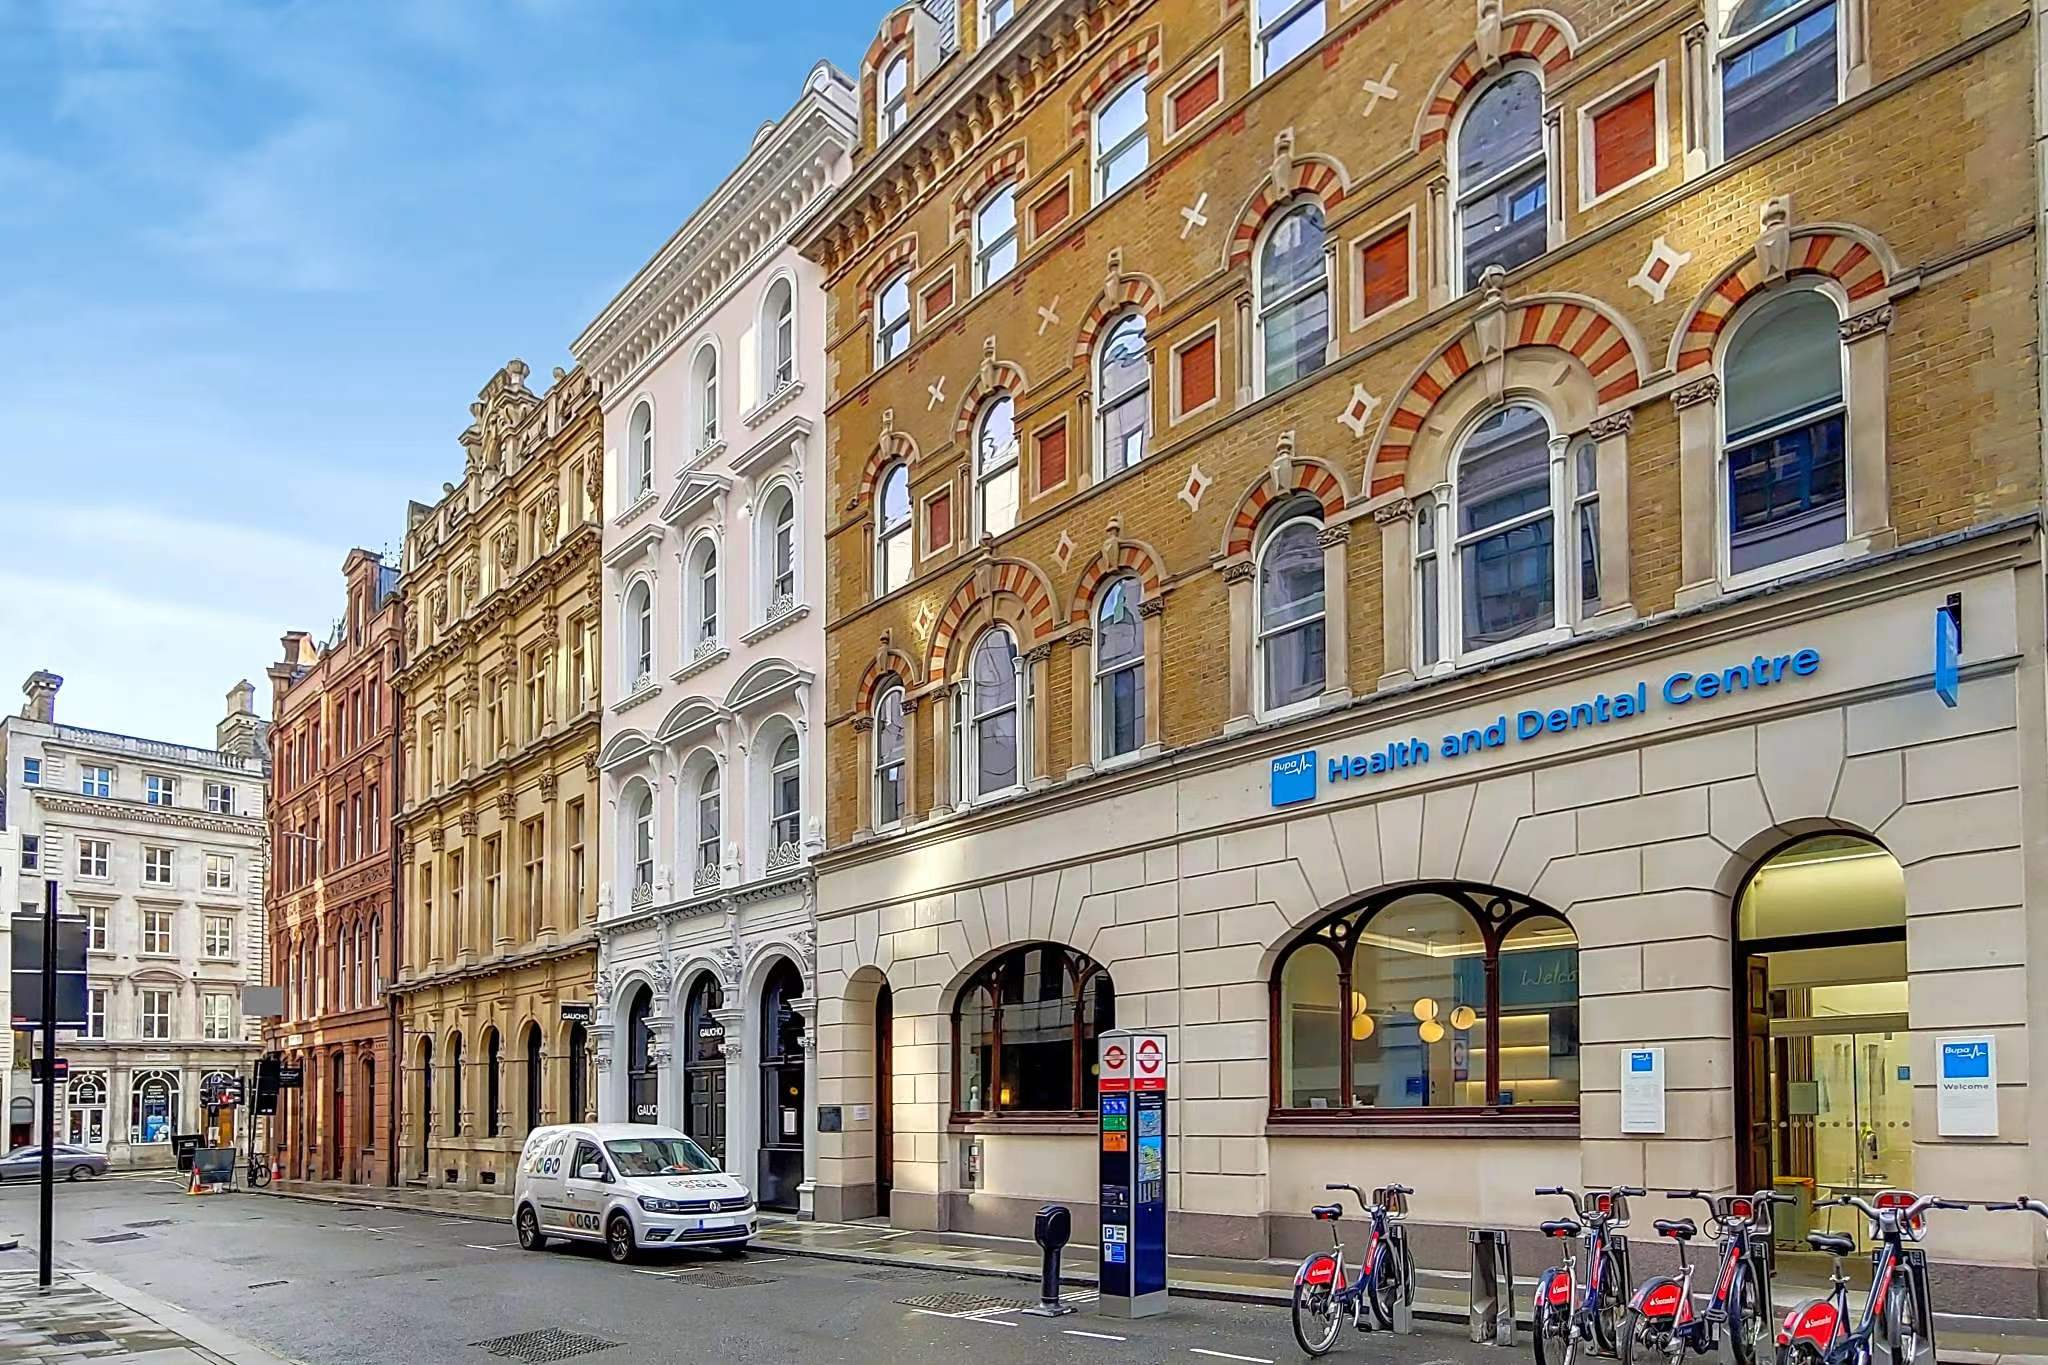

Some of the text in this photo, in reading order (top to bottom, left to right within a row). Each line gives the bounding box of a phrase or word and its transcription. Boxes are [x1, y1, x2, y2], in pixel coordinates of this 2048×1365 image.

[1328, 647, 1820, 783] Health and Dental Centre
[1273, 760, 1297, 773] Bupa
[562, 1012, 588, 1020] GAUCHO
[699, 1026, 723, 1038] GAUCHO
[1944, 1045, 1970, 1055] Bupa
